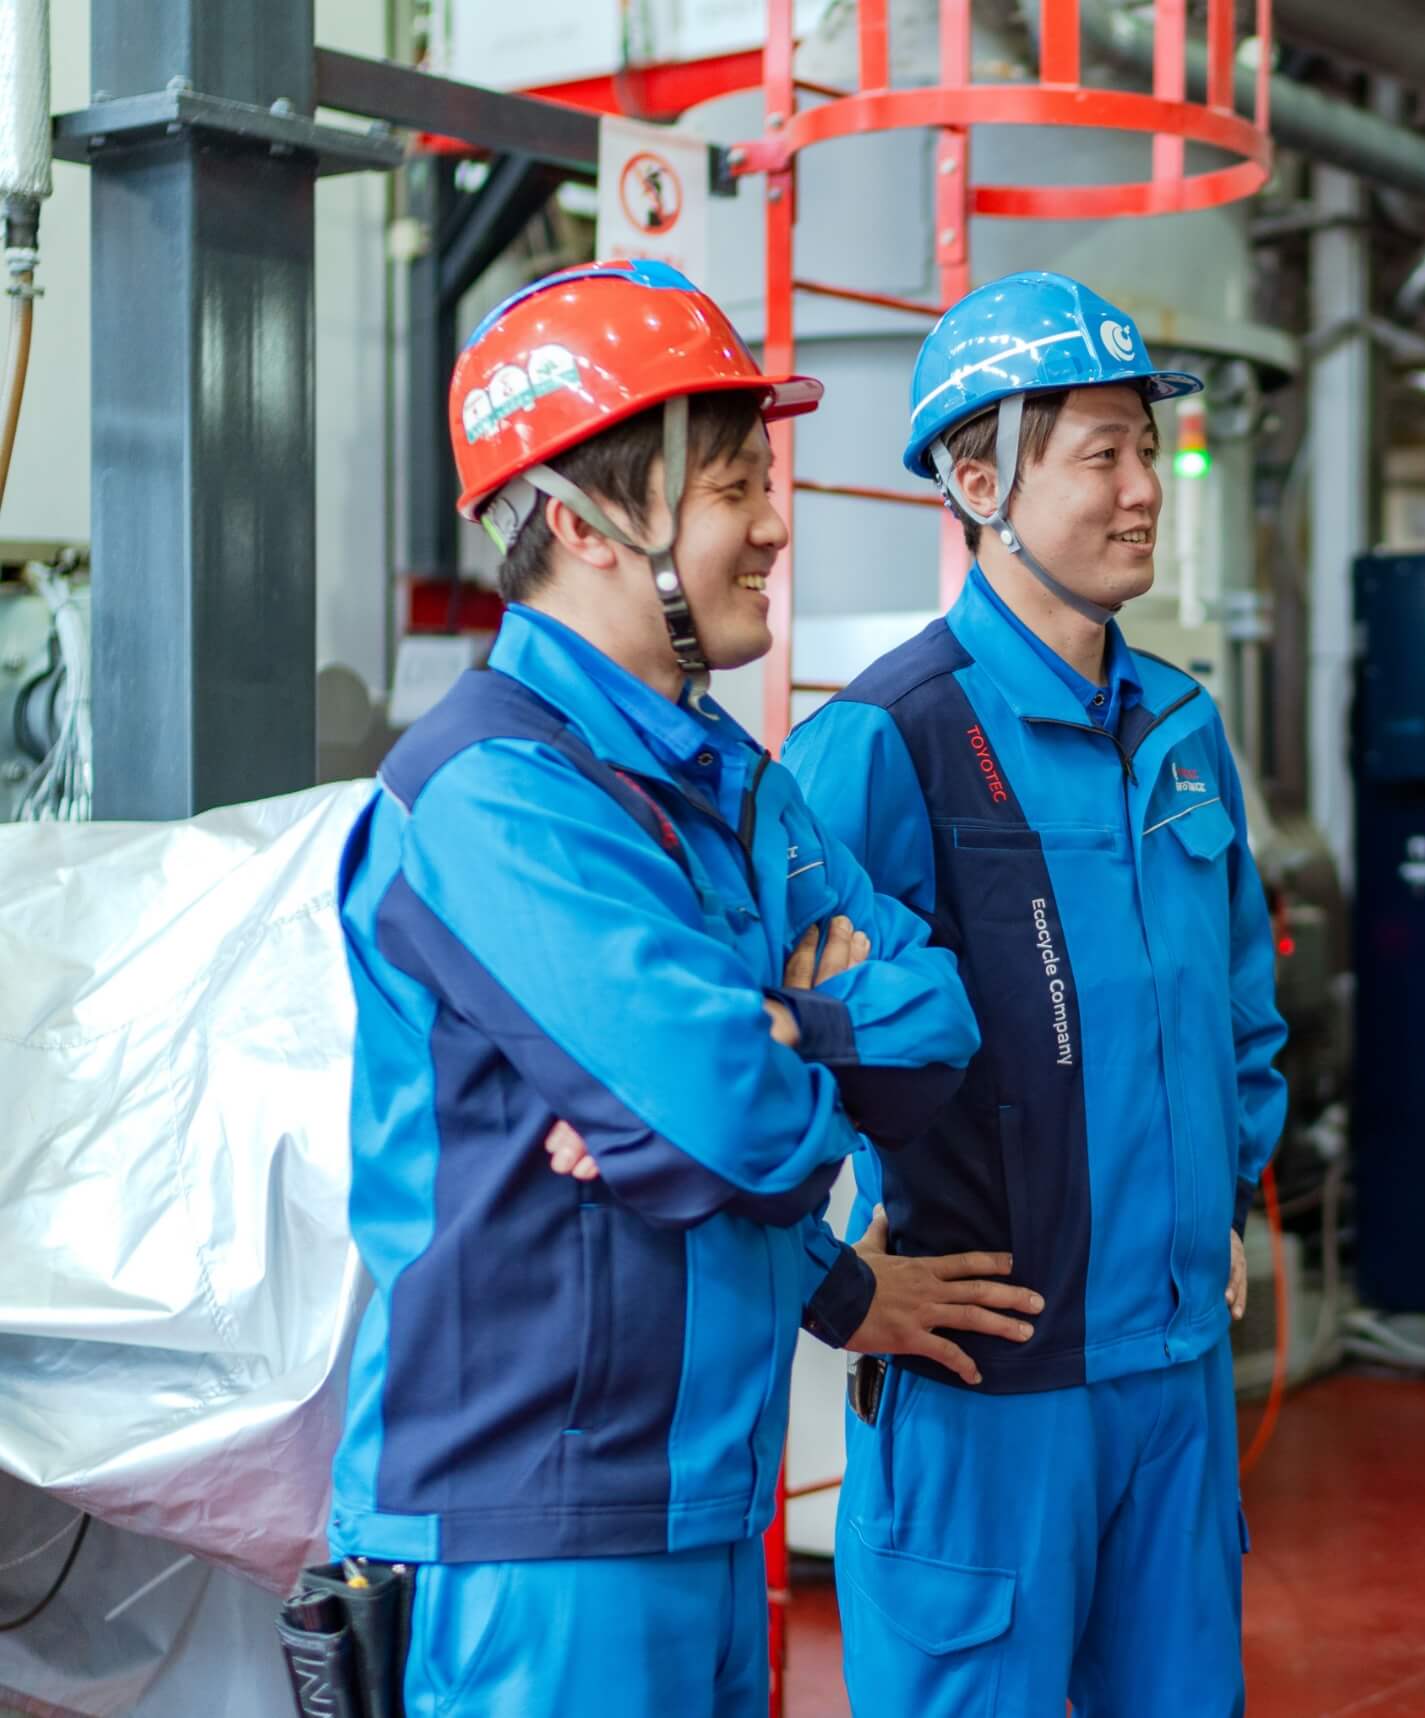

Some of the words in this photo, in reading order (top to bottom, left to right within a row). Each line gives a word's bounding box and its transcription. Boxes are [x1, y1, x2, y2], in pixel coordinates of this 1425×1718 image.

[967, 724, 1007, 803] TOYOTEC
[1031, 898, 1060, 976] Ecocycle
[1049, 979, 1073, 1066] Company
